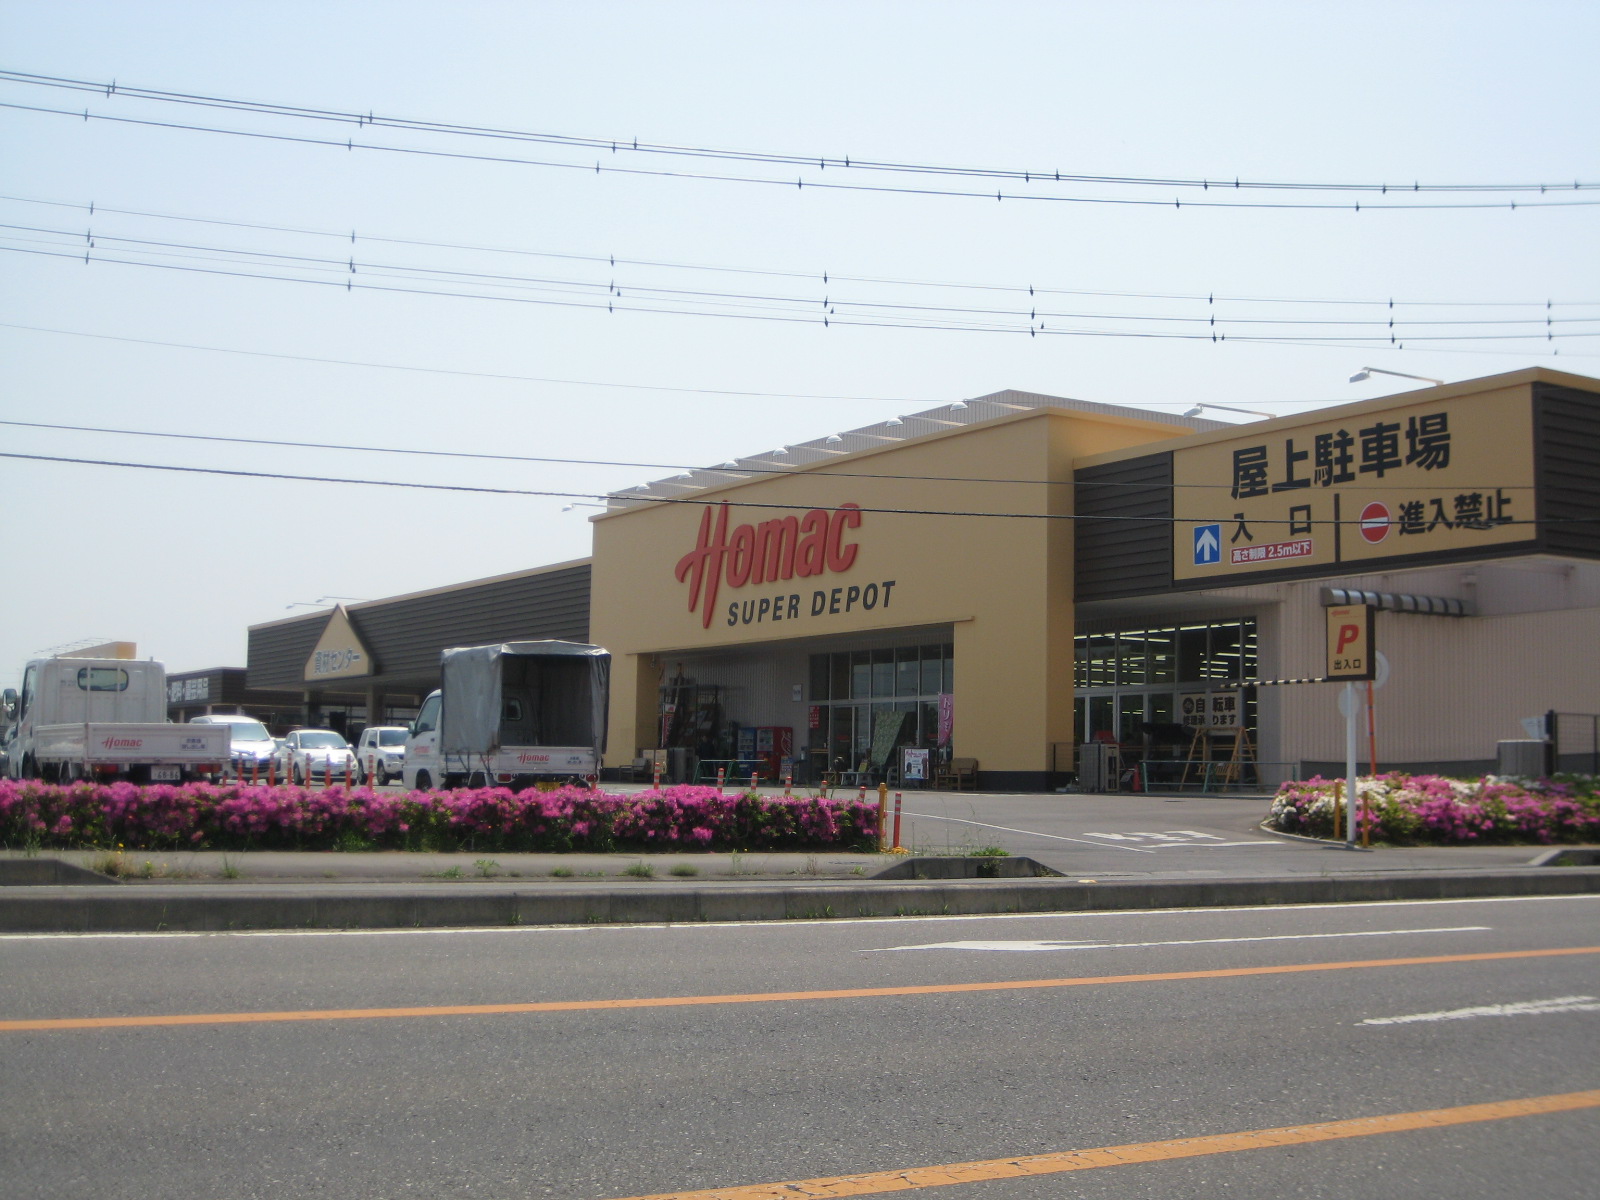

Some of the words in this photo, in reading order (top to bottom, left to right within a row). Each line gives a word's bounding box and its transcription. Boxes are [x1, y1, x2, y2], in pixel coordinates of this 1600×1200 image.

[1231, 412, 1450, 500] 屋上駐車場
[1398, 487, 1513, 536] 進入禁止
[1232, 547, 1266, 562] 高さ制限
[1268, 541, 1311, 558] 2.5m以下
[675, 500, 861, 630] Homac
[727, 594, 800, 627] SUPER
[811, 580, 896, 617] DEPOT
[1336, 624, 1360, 655] P
[1334, 659, 1361, 671] 出入口
[1195, 696, 1236, 714] 自転車
[101, 736, 143, 750] Homac
[517, 751, 550, 764] Homac
